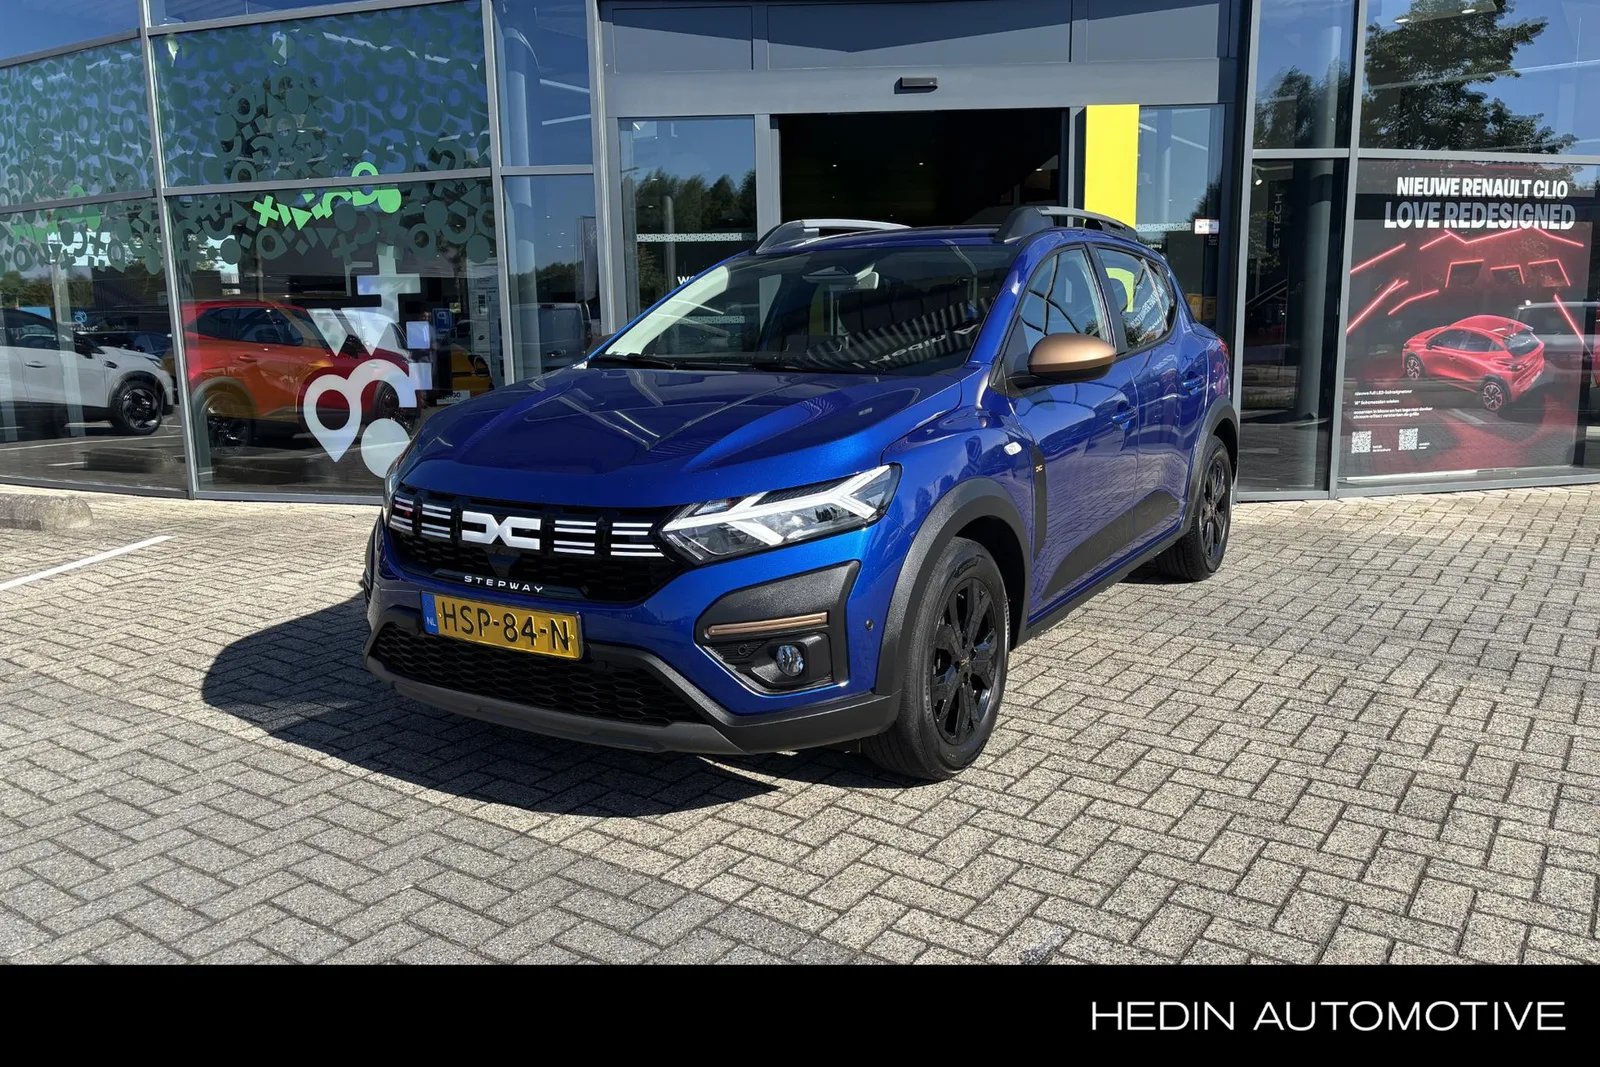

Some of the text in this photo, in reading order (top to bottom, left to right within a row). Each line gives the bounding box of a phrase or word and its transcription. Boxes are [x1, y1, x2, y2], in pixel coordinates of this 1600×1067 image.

[1397, 177, 1569, 200] NIEUWE RENAULT CLIO
[1384, 201, 1576, 230] LOVE REDESIGNED
[464, 575, 543, 593] STEPWAY
[426, 616, 437, 627] NL
[441, 601, 570, 651] HSP-84-N
